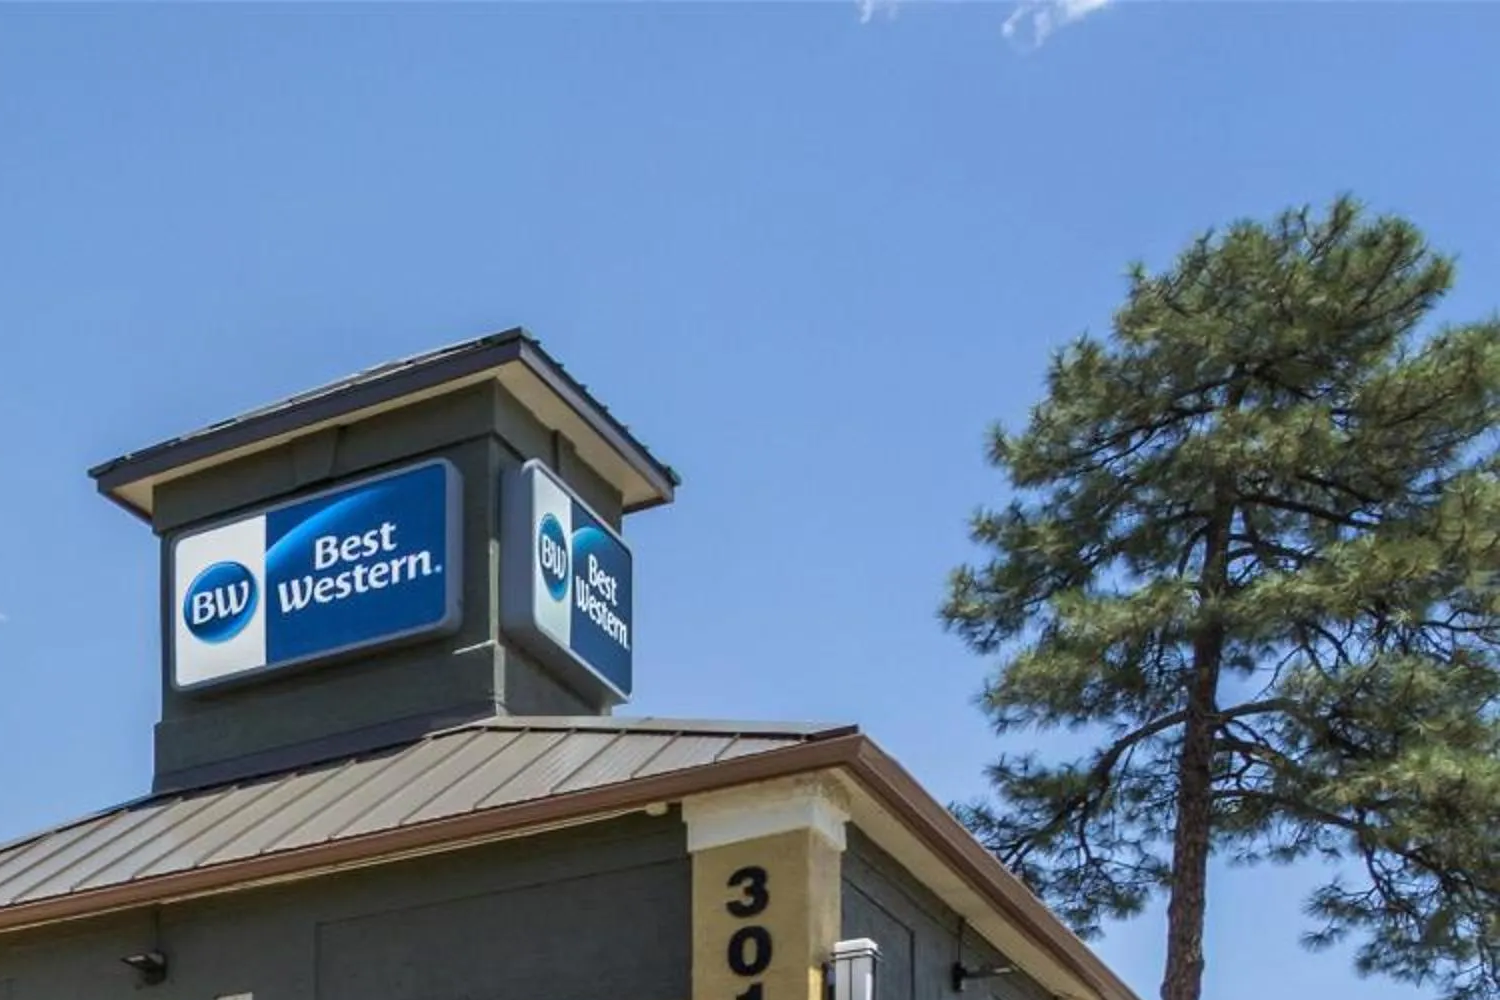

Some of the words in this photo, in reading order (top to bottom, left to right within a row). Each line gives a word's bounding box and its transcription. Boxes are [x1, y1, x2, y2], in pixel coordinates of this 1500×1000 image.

[314, 521, 397, 570] Best
[541, 534, 567, 580] BW
[191, 579, 249, 625] BW
[588, 554, 617, 607] Best
